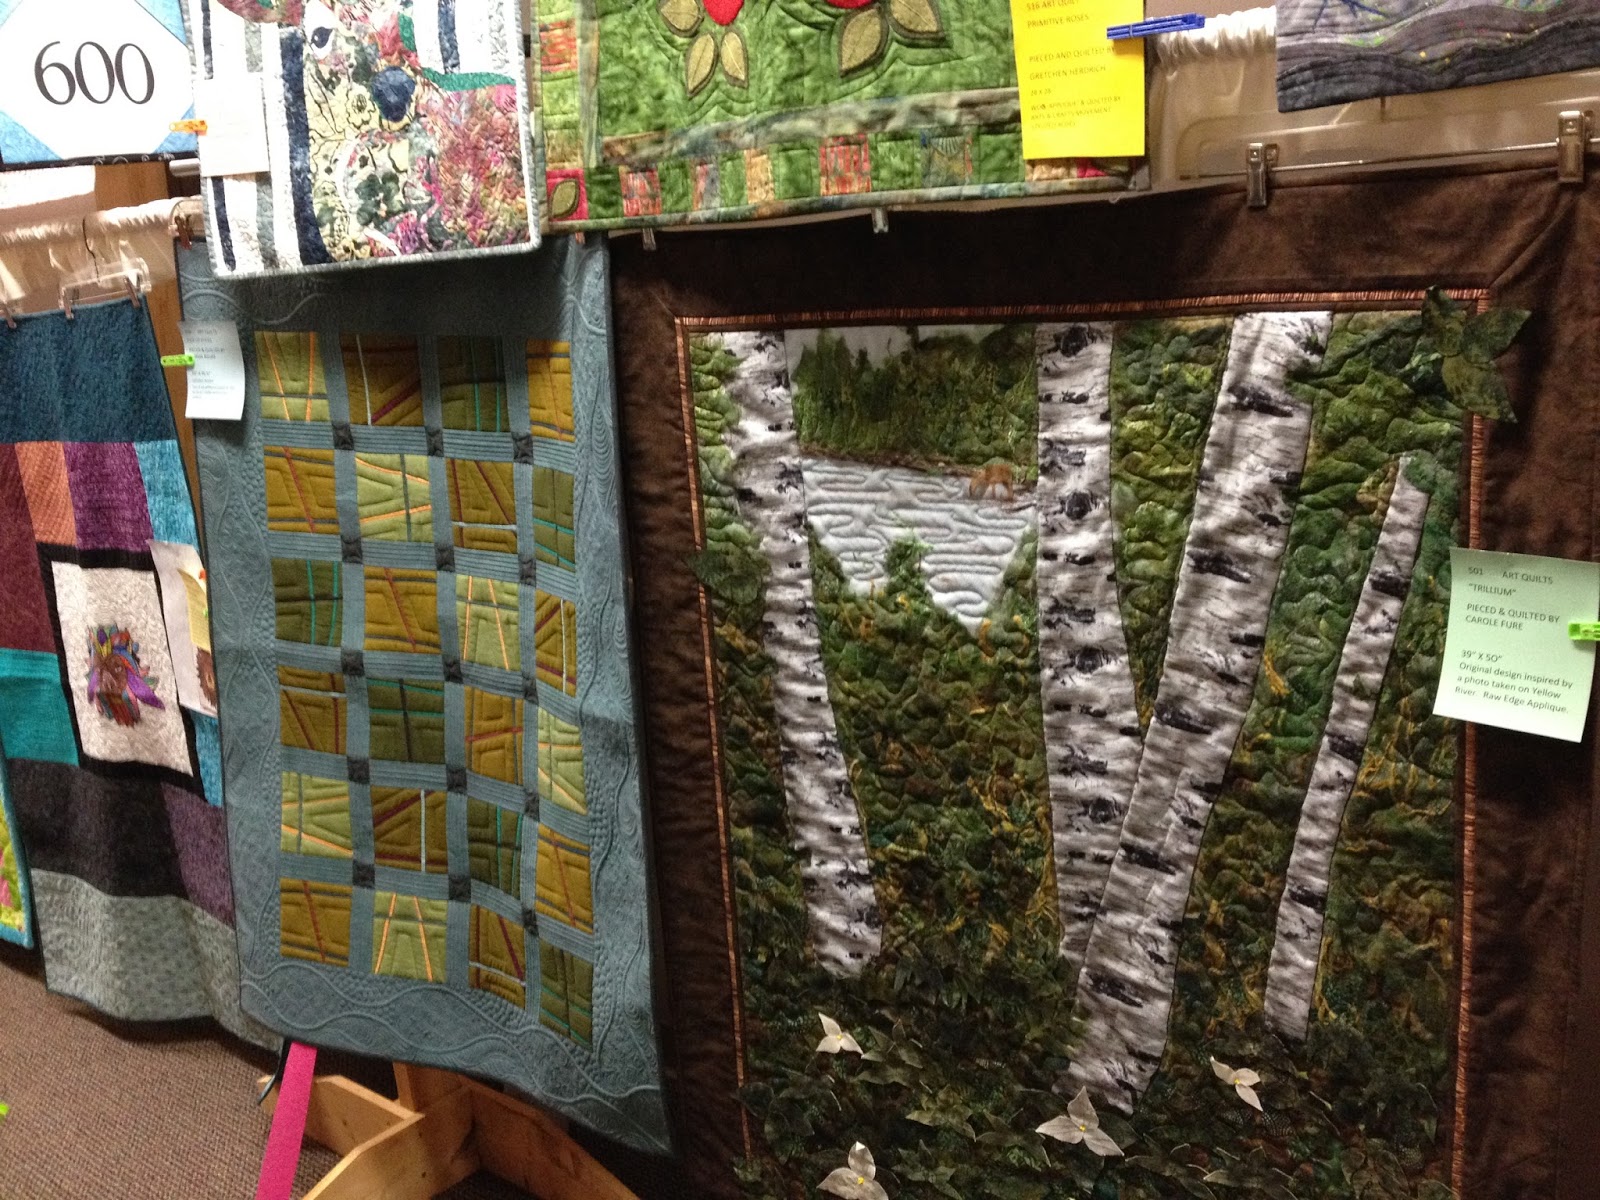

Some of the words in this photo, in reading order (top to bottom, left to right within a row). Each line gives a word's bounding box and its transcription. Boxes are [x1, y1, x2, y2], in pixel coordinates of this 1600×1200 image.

[1042, 0, 1055, 9] ART
[1027, 17, 1063, 28] PRIMITIVE
[1066, 14, 1089, 23] ROSES
[1029, 53, 1054, 63] PIECED
[1056, 51, 1072, 60] AND
[1074, 48, 1105, 58] QUILTED
[1107, 46, 1115, 54] BY
[34, 41, 155, 105] 600
[1029, 68, 1068, 80] GRETCHEN
[1468, 567, 1484, 576] 501
[1502, 571, 1519, 580] ART
[1521, 573, 1554, 585] QUILTS
[1468, 582, 1516, 596] "TRILLIUM"
[1466, 603, 1497, 614] PIECED
[1499, 607, 1506, 616] &
[1508, 609, 1546, 622] QUILTED
[1548, 615, 1561, 624] BY
[1465, 615, 1499, 627] CAROLE
[1500, 619, 1524, 631] FURE
[1459, 661, 1492, 674] Original
[1493, 668, 1522, 680] design
[1524, 672, 1560, 686] inspired
[1561, 679, 1574, 689] by
[1464, 675, 1490, 687] photo
[1491, 680, 1516, 691] taken
[1531, 687, 1562, 699] Yellow
[1483, 691, 1501, 701] Raw
[1503, 694, 1525, 706] Edge
